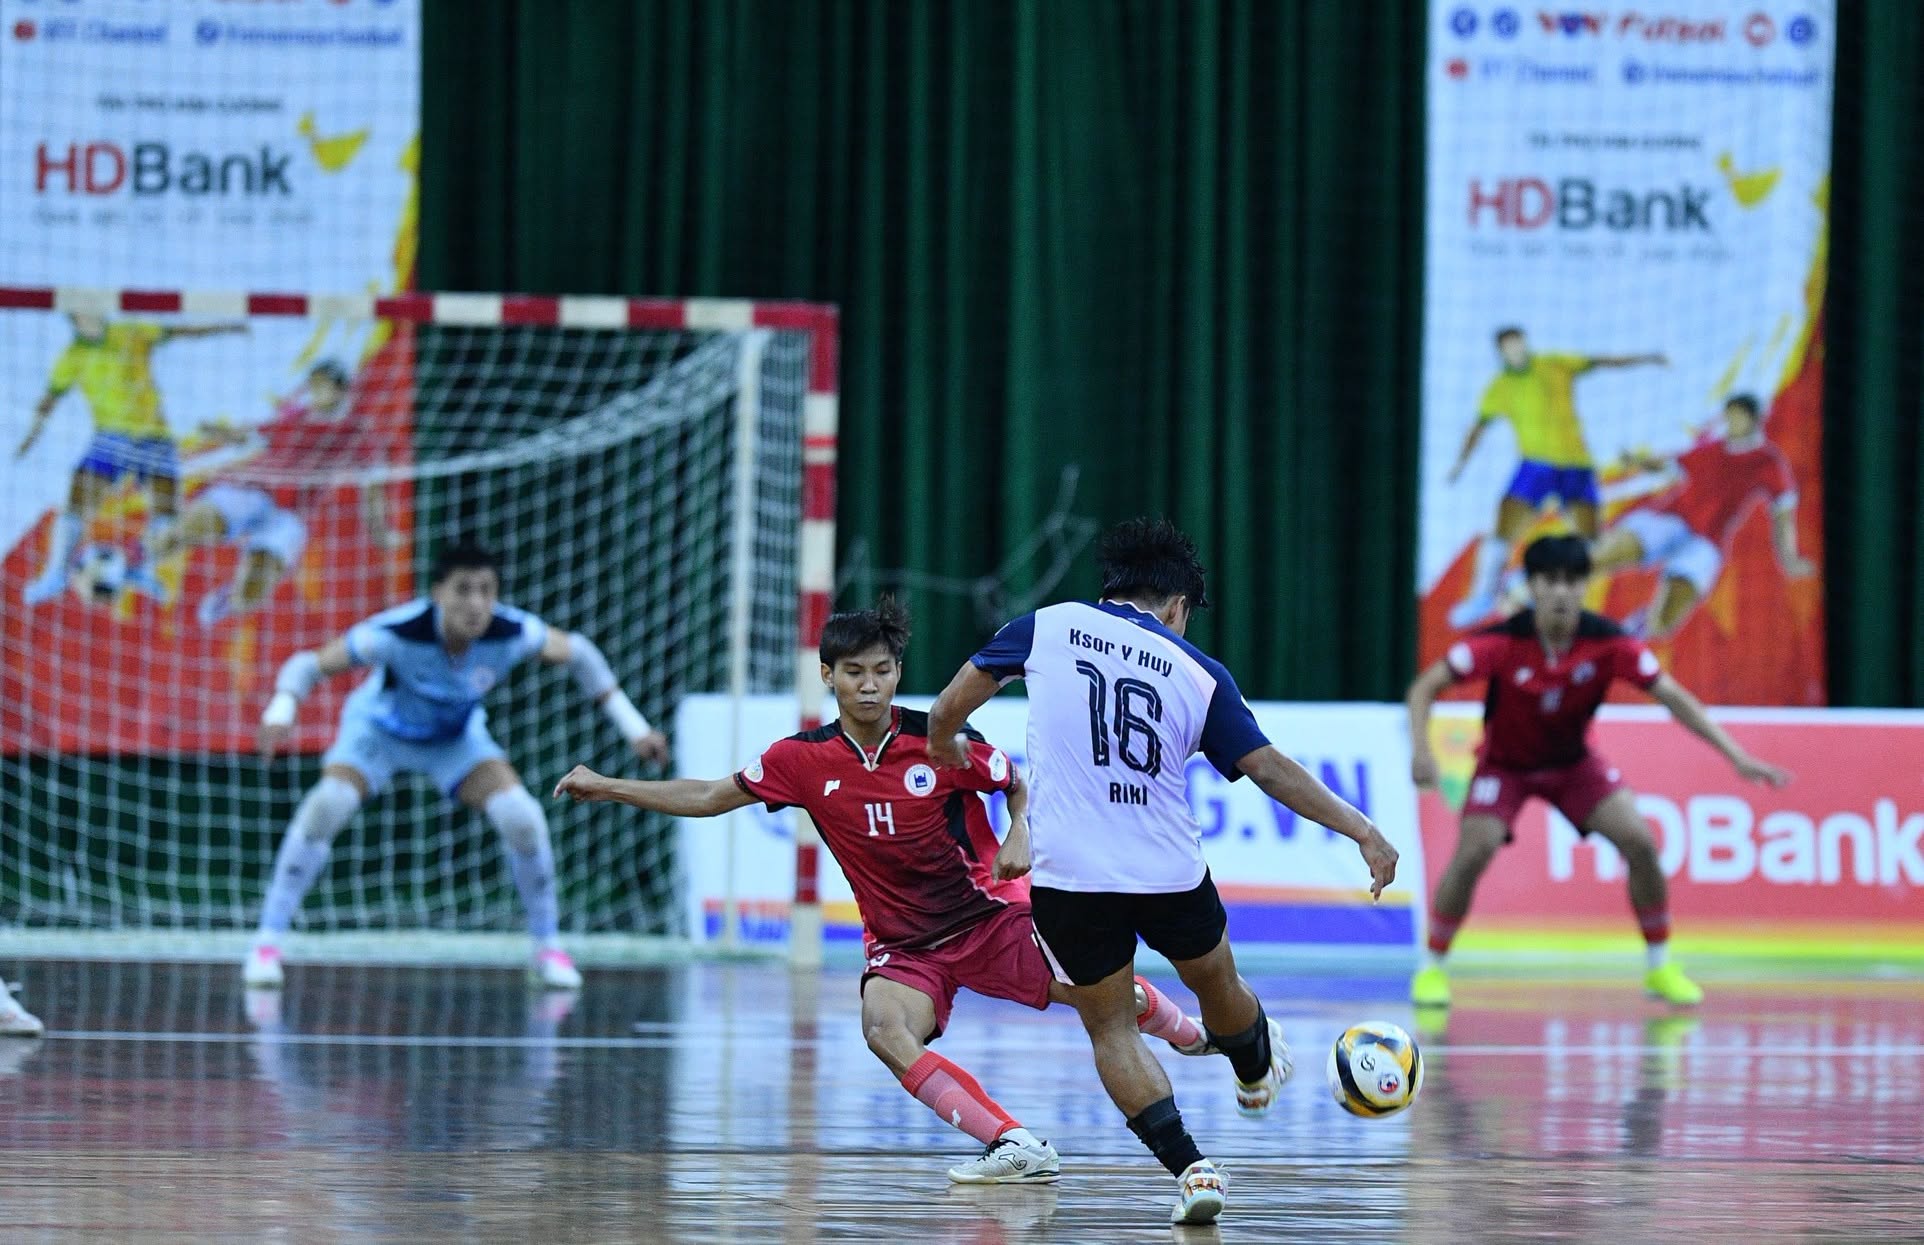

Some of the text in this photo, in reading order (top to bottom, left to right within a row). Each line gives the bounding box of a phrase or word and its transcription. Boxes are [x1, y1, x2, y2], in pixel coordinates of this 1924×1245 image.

[35, 143, 293, 195] HDBank
[1467, 177, 1711, 230] HDBank
[1069, 628, 1115, 655] Ksor
[1075, 659, 1163, 780] 16
[864, 802, 896, 837] 14
